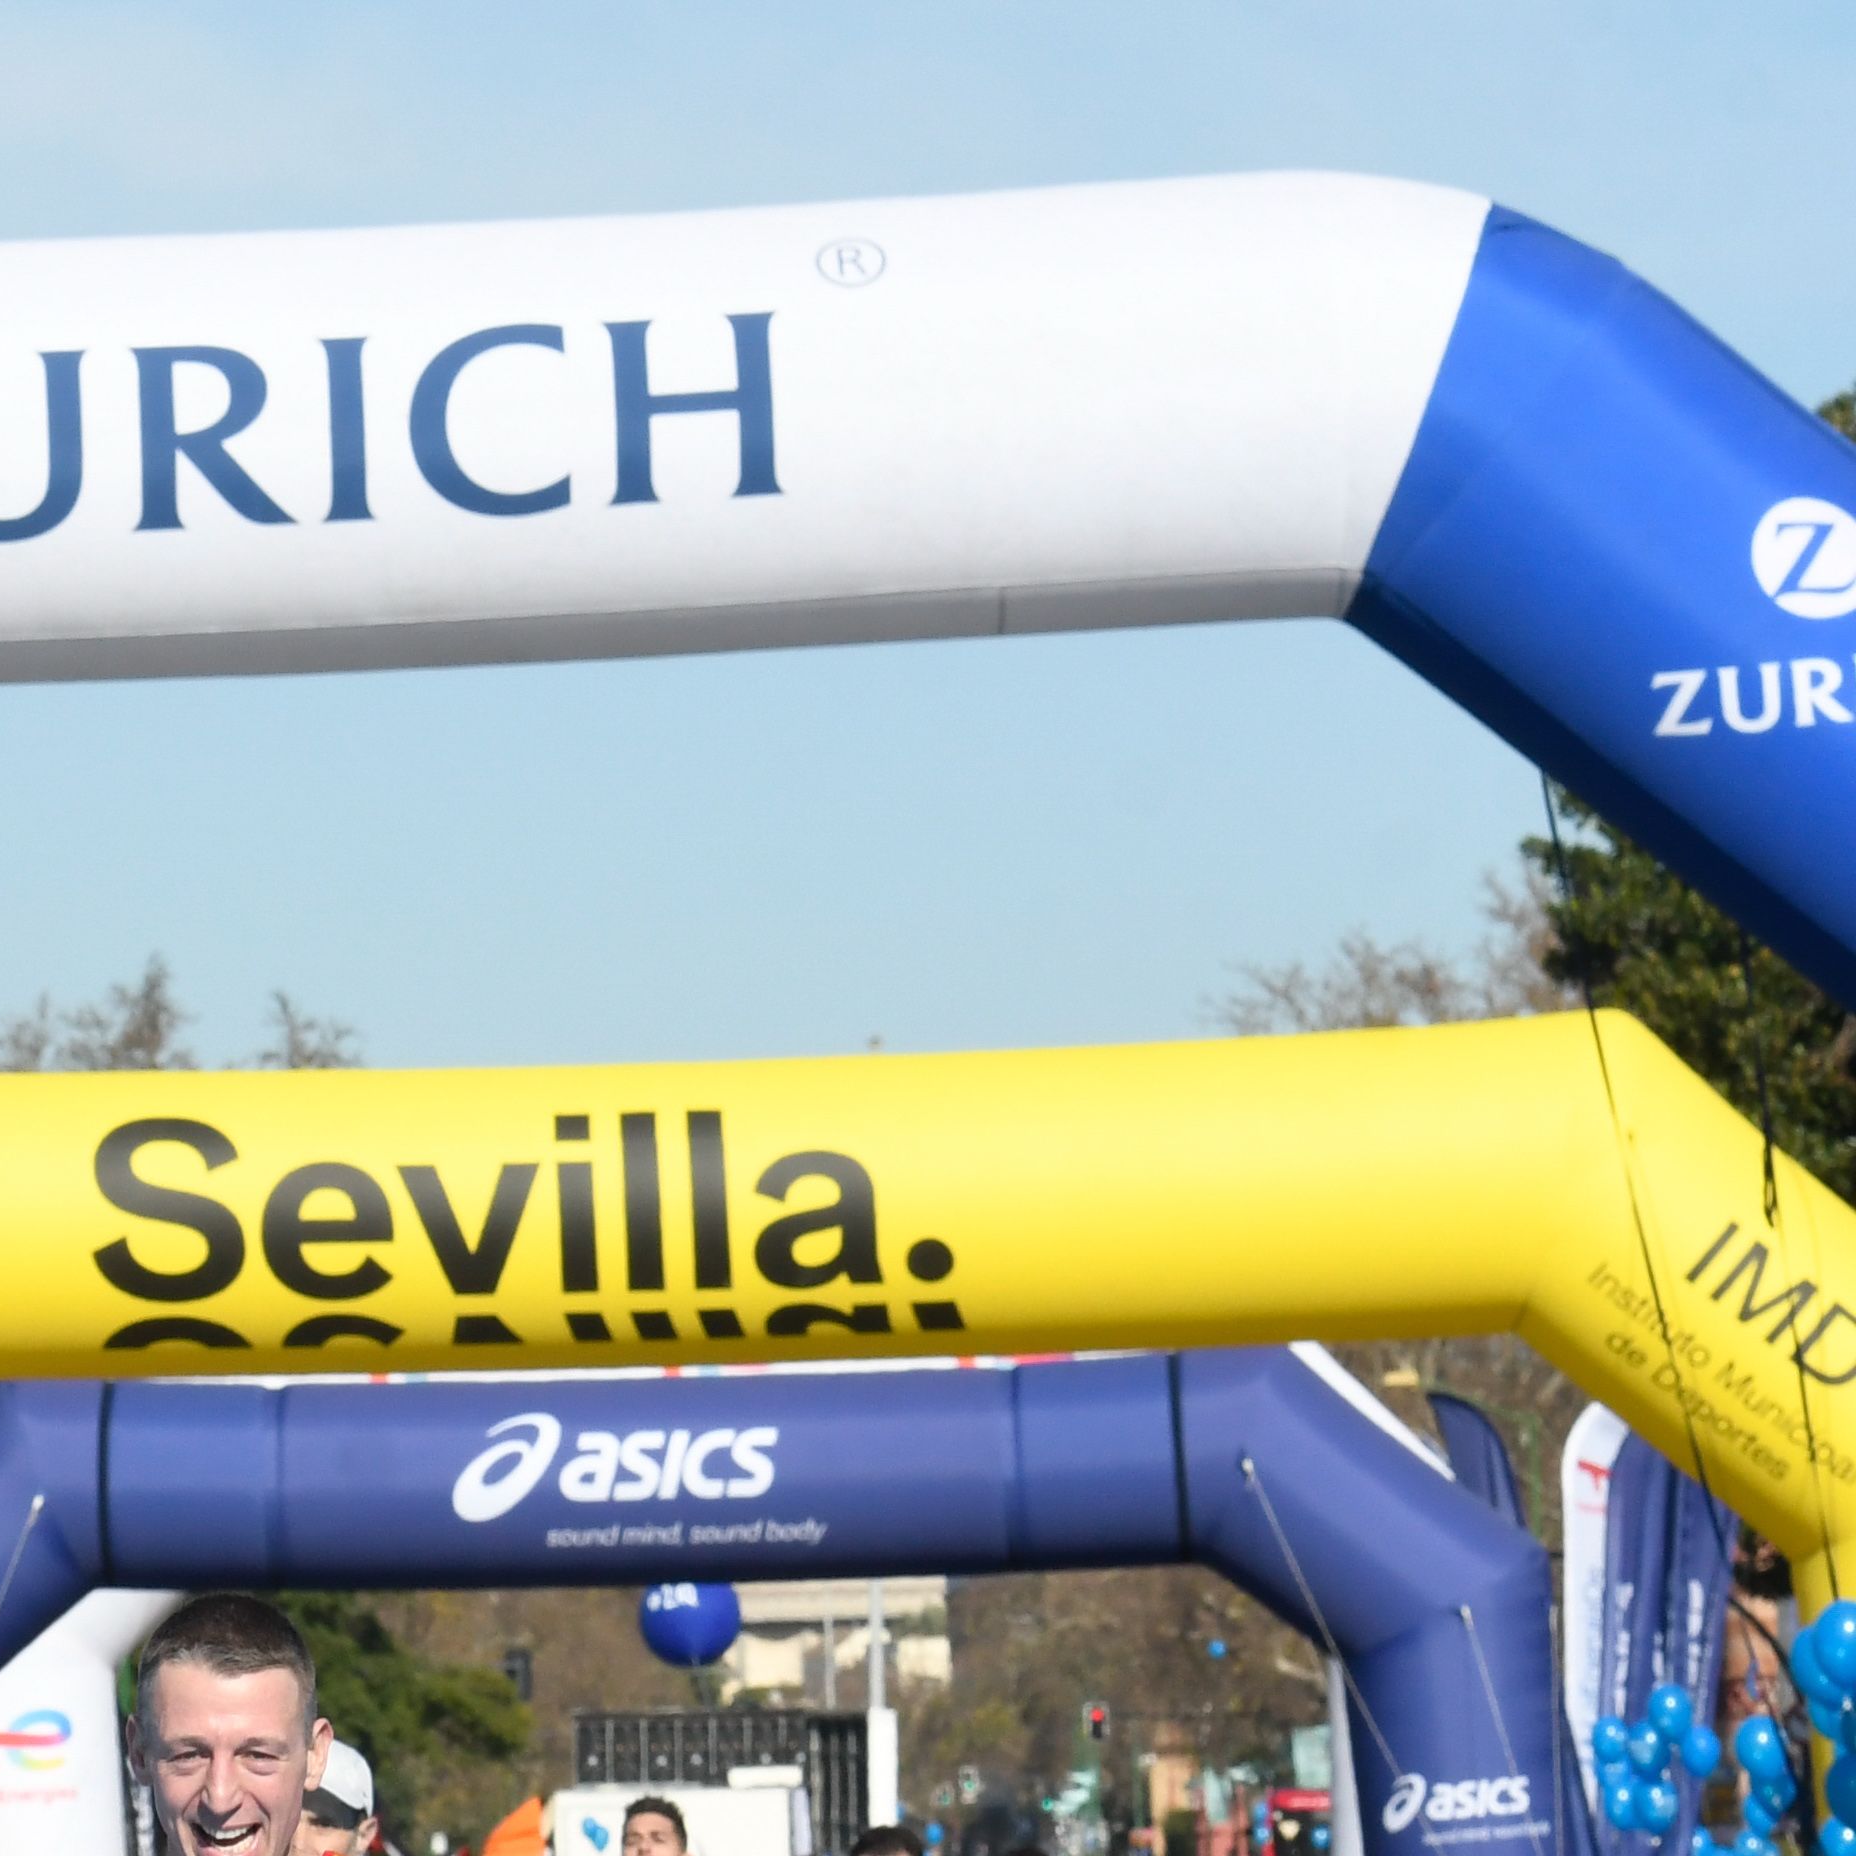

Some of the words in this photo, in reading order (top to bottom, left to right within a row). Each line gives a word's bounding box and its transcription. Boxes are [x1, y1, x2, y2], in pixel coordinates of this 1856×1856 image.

[1650, 655, 1856, 737] ZUR
[91, 1109, 957, 1304] Sevilla.
[1685, 1222, 1856, 1386] IMD
[1604, 1330, 1648, 1367] de
[558, 1426, 779, 1503] asics
[1425, 1774, 1531, 1822] asics
